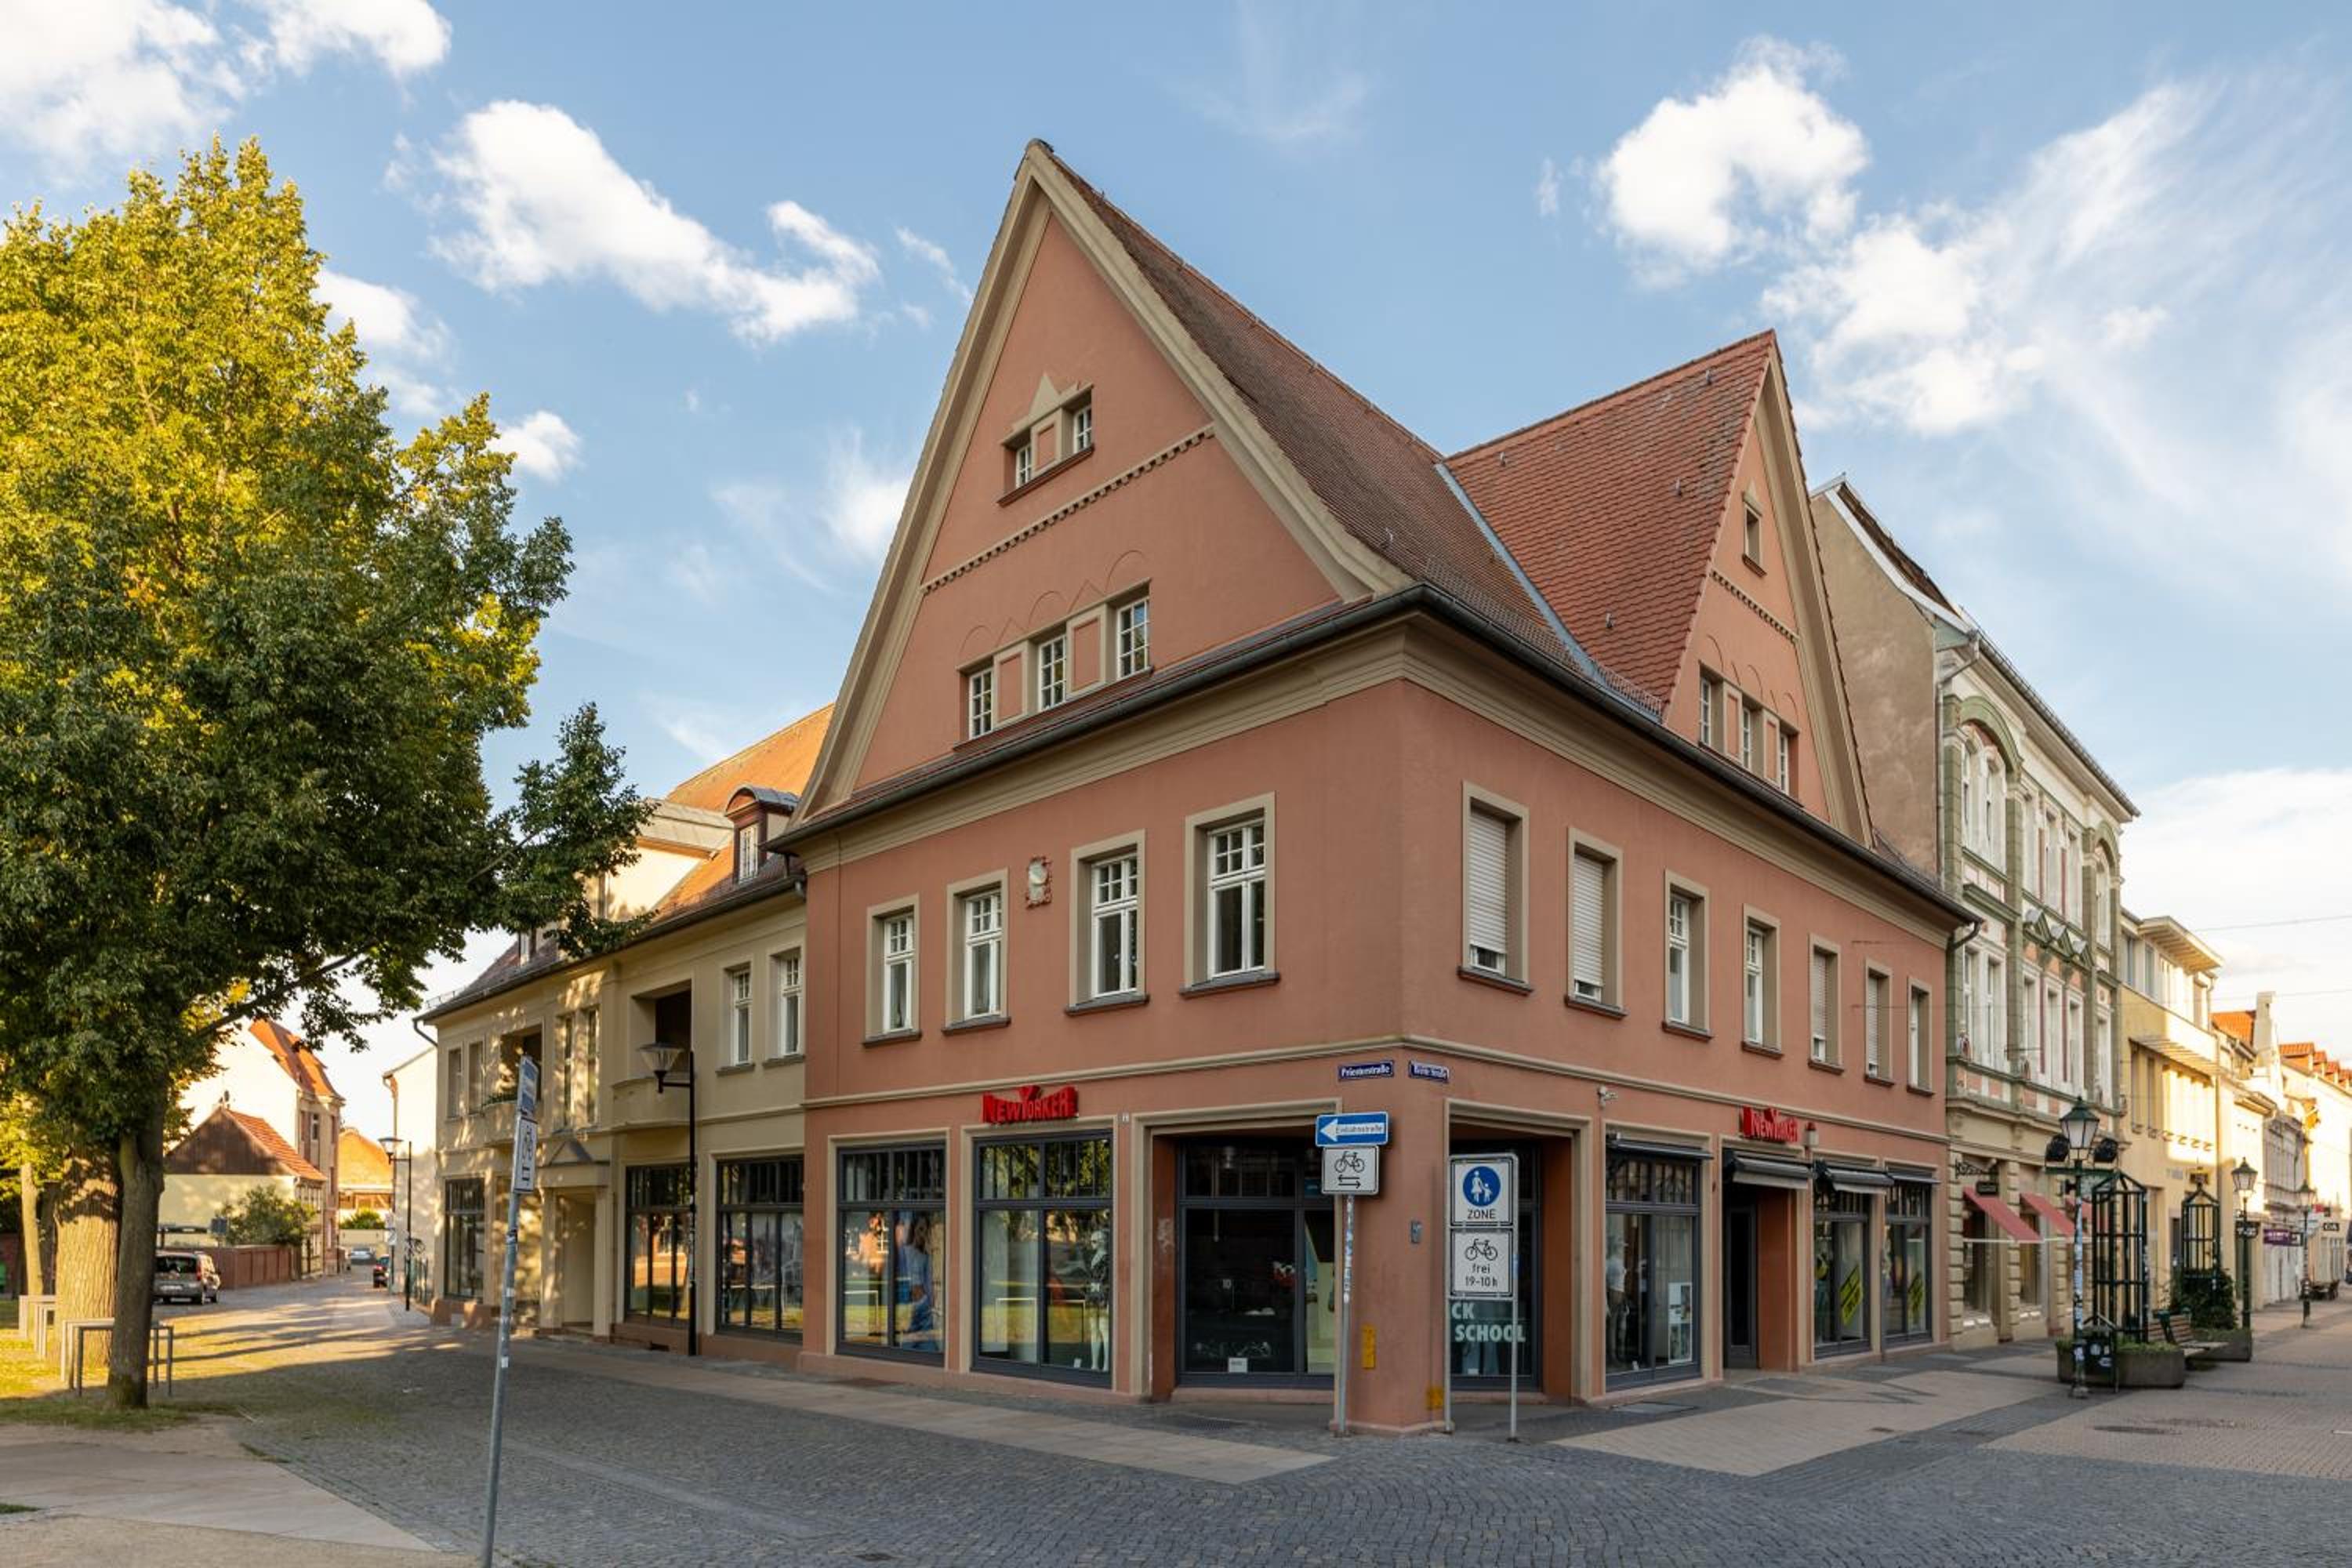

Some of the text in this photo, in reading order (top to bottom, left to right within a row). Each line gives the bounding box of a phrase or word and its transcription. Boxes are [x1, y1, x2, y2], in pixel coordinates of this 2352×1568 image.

[1467, 1208, 1497, 1219] ZONE
[1472, 1263, 1491, 1273] frei
[1454, 1323, 1526, 1343] SCHOOL
